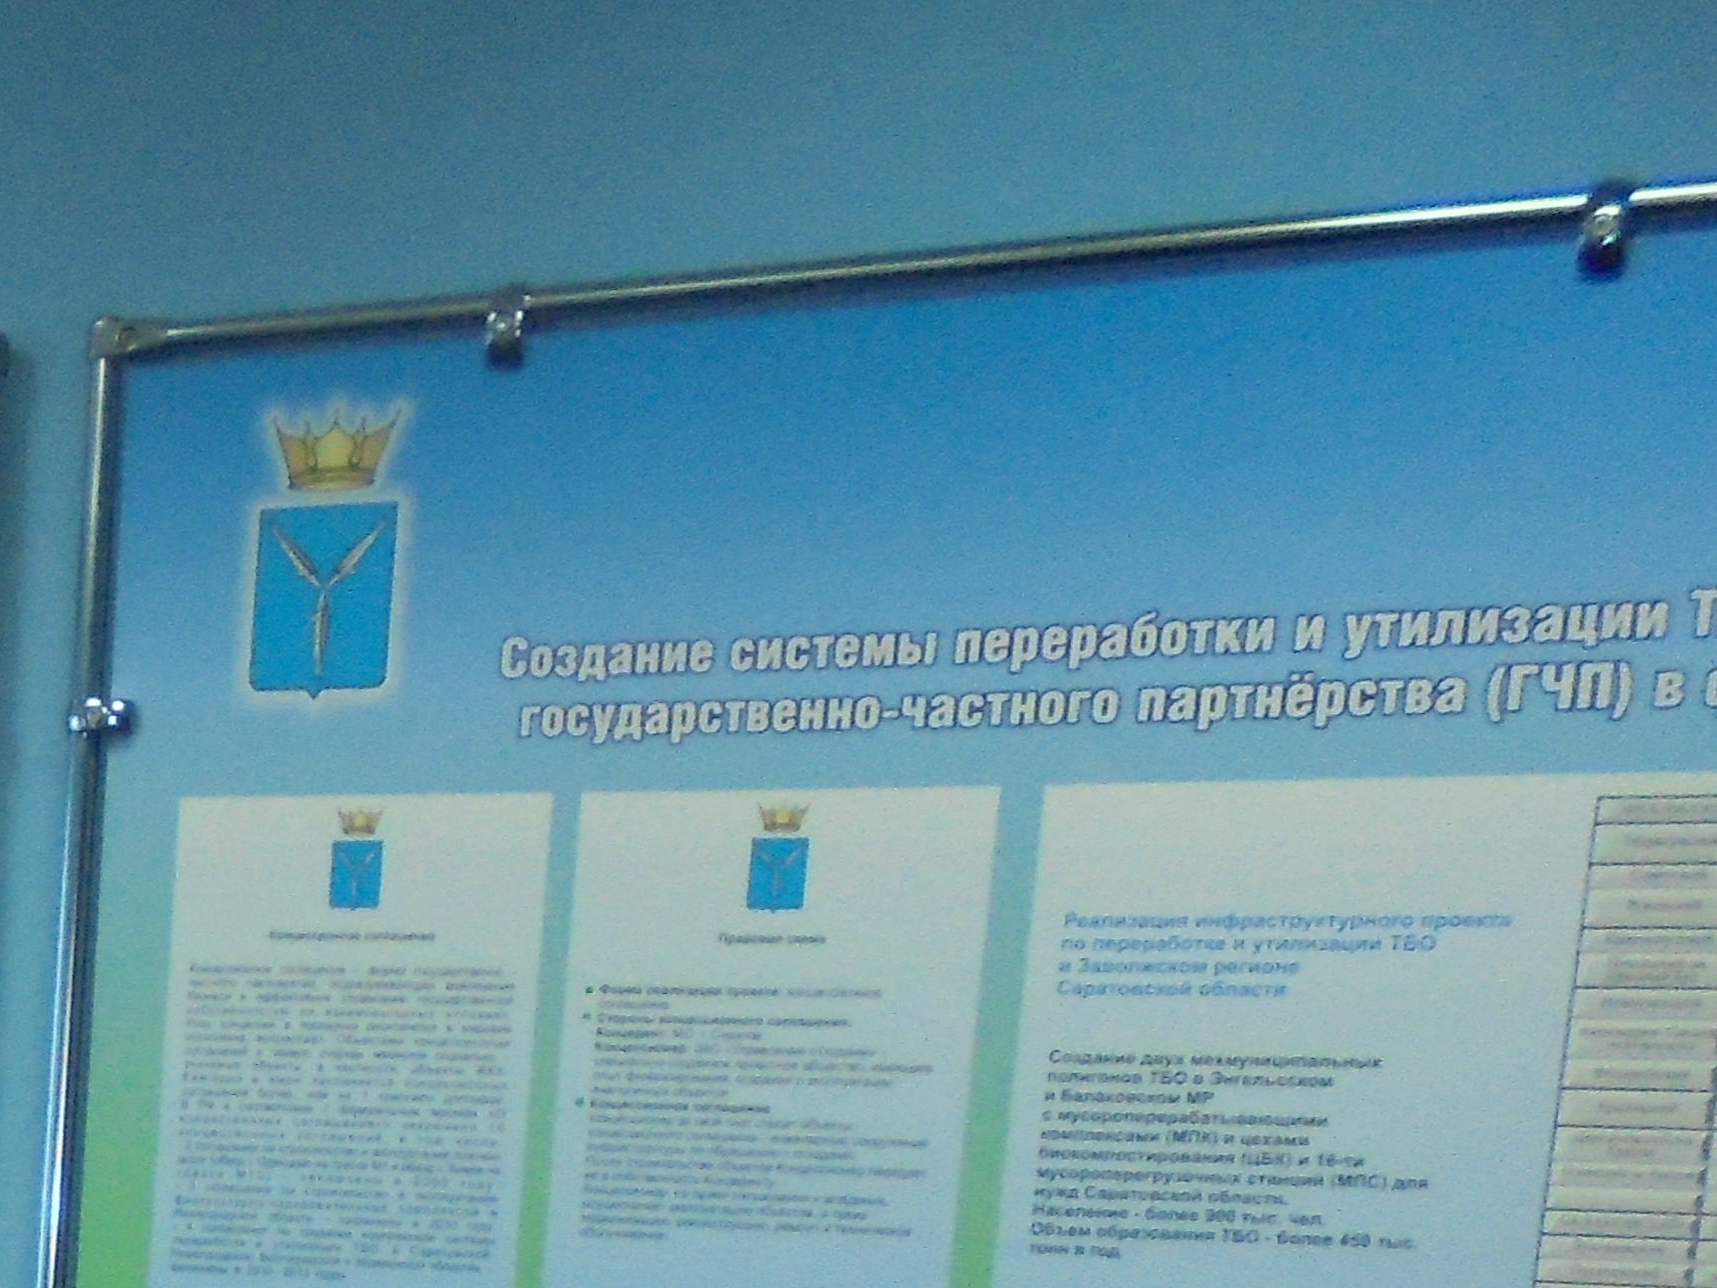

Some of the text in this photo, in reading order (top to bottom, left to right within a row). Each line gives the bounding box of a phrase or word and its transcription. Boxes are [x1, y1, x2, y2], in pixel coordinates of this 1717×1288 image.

[501, 635, 714, 682] Создание
[730, 630, 936, 671] системы
[954, 611, 1274, 674] переработки
[1294, 614, 1325, 651] и
[1343, 599, 1668, 660] утилизации
[518, 687, 1119, 744] государственно-частного
[1136, 671, 1466, 731] партнёрства
[1486, 661, 1633, 722] (ГЧП)
[1654, 670, 1685, 708] в
[1065, 912, 1512, 932] Реализация инфраструктурного проекта
[1062, 934, 1438, 954] по переработке и утилизации ТБО
[1214, 961, 1299, 976] регионе
[1057, 980, 1287, 998] Саратовской области
[1049, 1049, 1136, 1066] Создание
[1139, 1053, 1185, 1068] двух
[1047, 1072, 1143, 1083] полигонов
[1150, 1070, 1188, 1086] ТБО
[1223, 1228, 1260, 1243] ТБО
